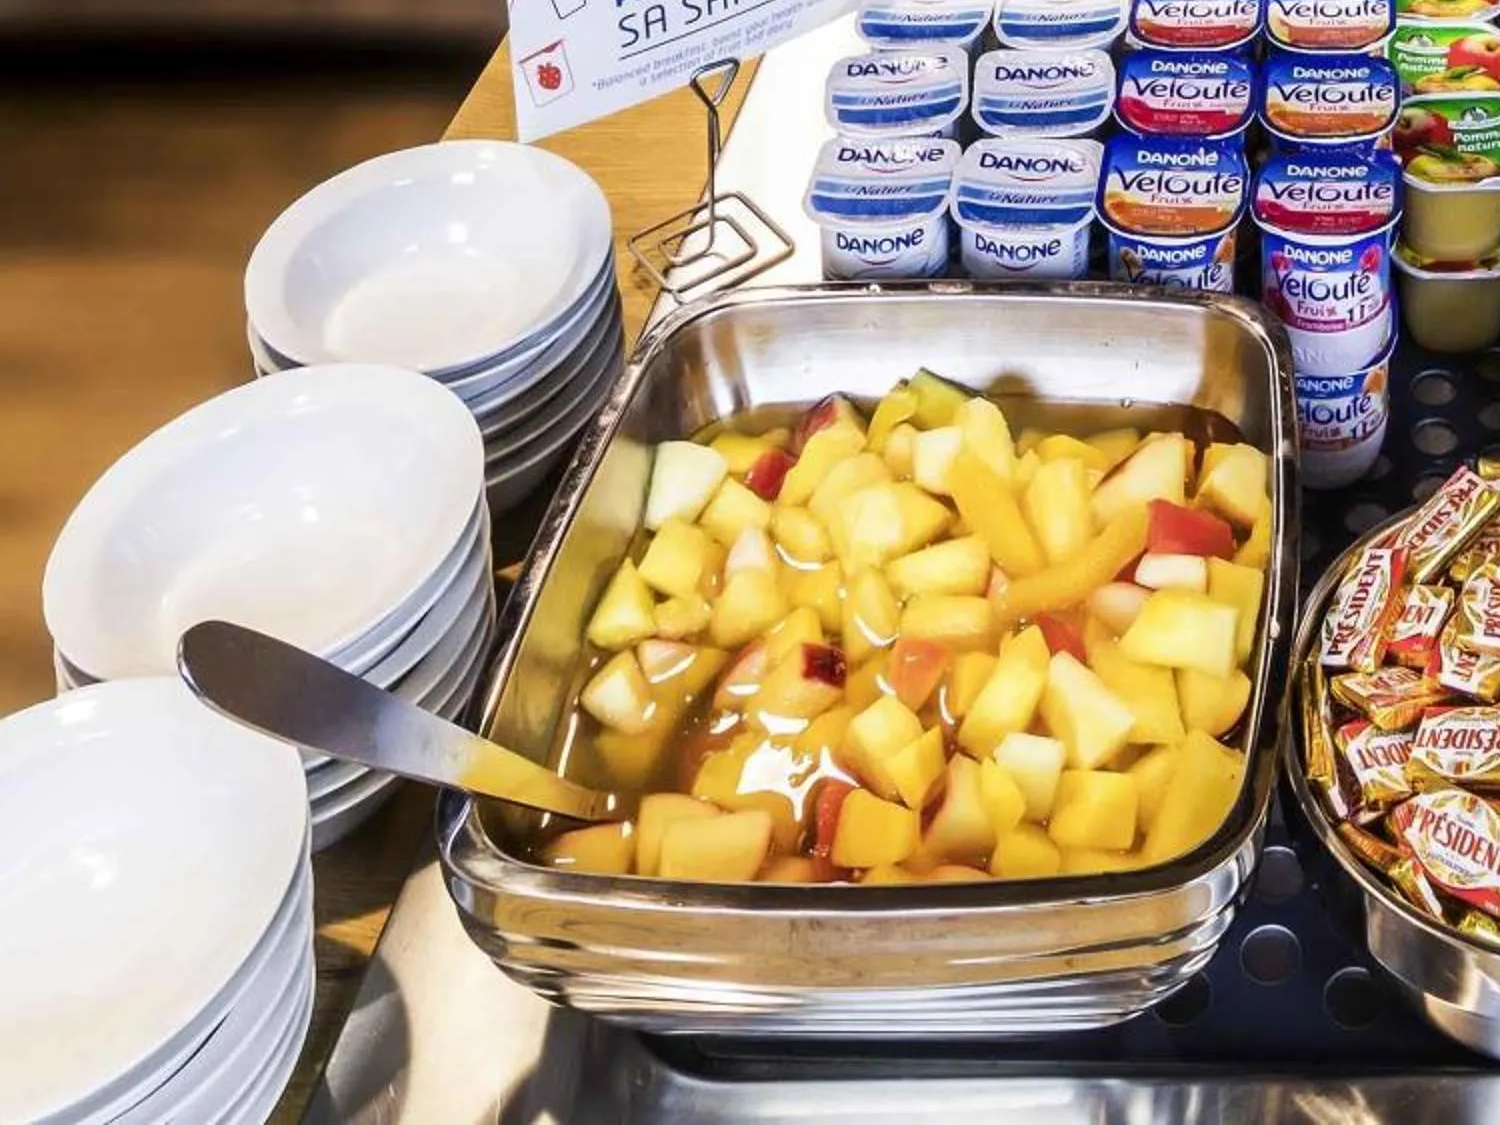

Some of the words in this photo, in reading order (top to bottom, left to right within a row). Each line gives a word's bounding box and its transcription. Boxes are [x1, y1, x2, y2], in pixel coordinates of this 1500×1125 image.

[618, 1, 668, 49] SA
[1151, 60, 1229, 75] DANONE
[1293, 66, 1371, 79] DANONE
[1129, 74, 1249, 100] Velouté
[1273, 81, 1394, 104] Velouté
[1137, 150, 1219, 167] DANONE
[1113, 167, 1242, 195] Velouté
[1287, 164, 1369, 178] DANONE
[1263, 178, 1392, 202] Velouté
[836, 227, 926, 255] DANONE
[975, 233, 1062, 261] DANONE
[1136, 245, 1207, 262] DANONE
[1283, 243, 1353, 264] DANONE
[1275, 268, 1372, 302] Velouté
[1296, 377, 1354, 393] ANONE
[1298, 394, 1372, 425] elouté
[1327, 551, 1386, 656] PRÉSIDENT
